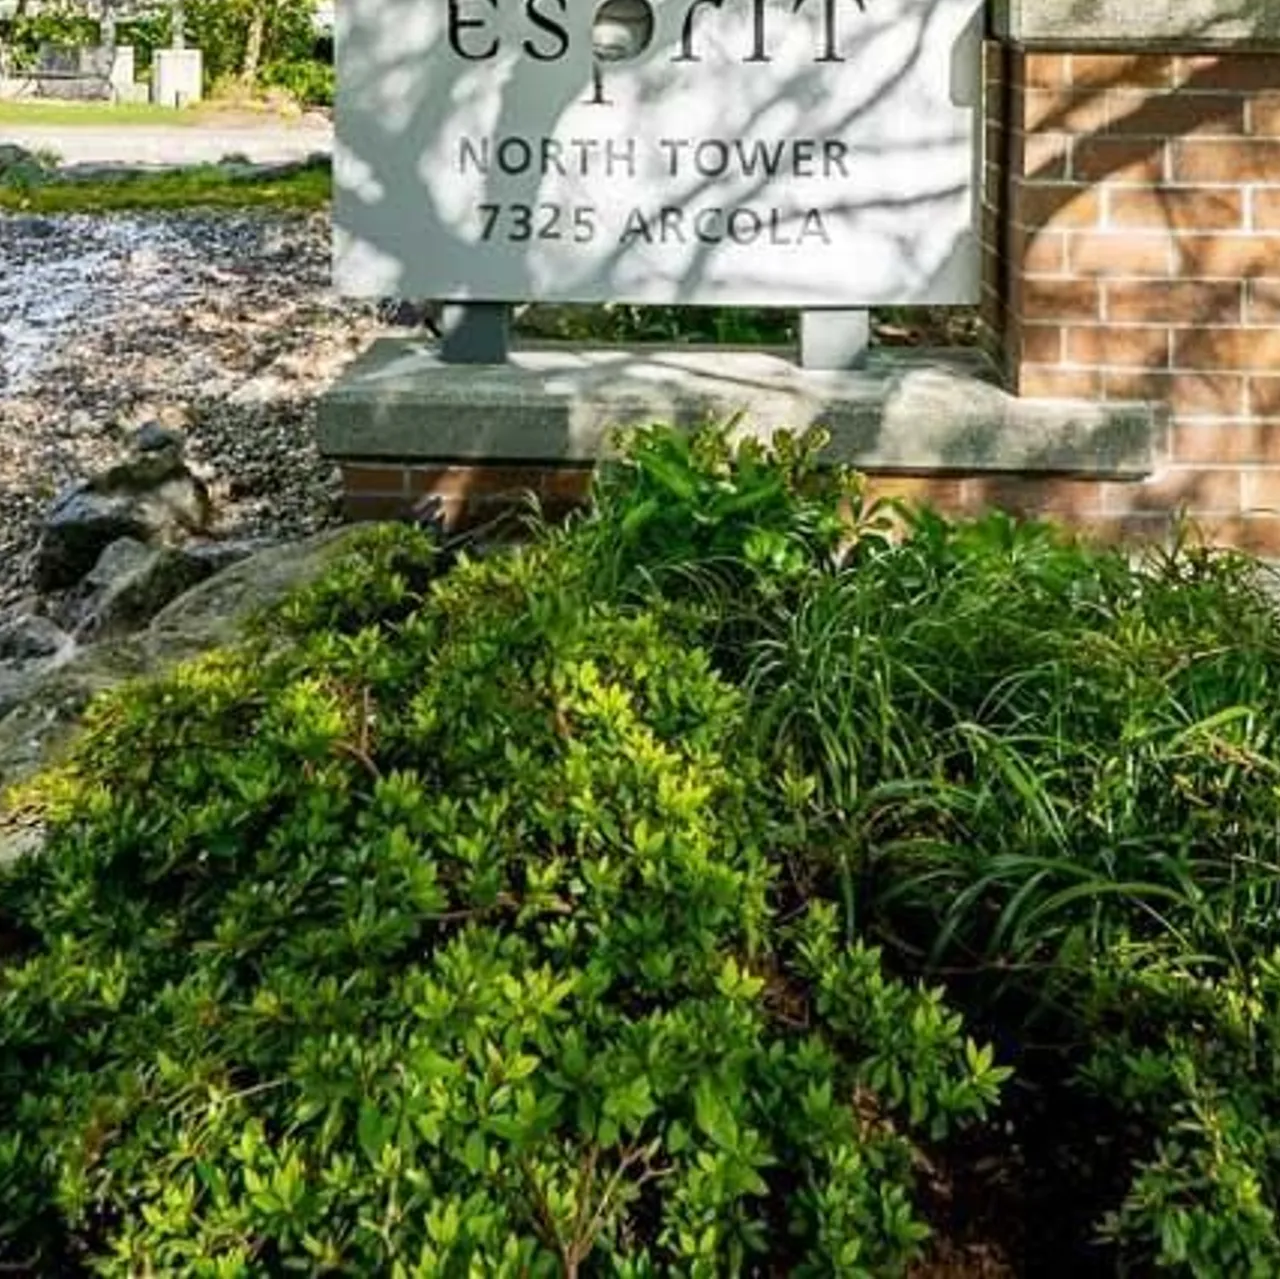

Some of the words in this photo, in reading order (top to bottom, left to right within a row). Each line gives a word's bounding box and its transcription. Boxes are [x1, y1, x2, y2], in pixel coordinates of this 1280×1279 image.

[459, 136, 637, 179] NORTH
[661, 137, 850, 179] TOWER
[477, 204, 596, 243] 7325
[621, 204, 832, 246] ARCOLA
